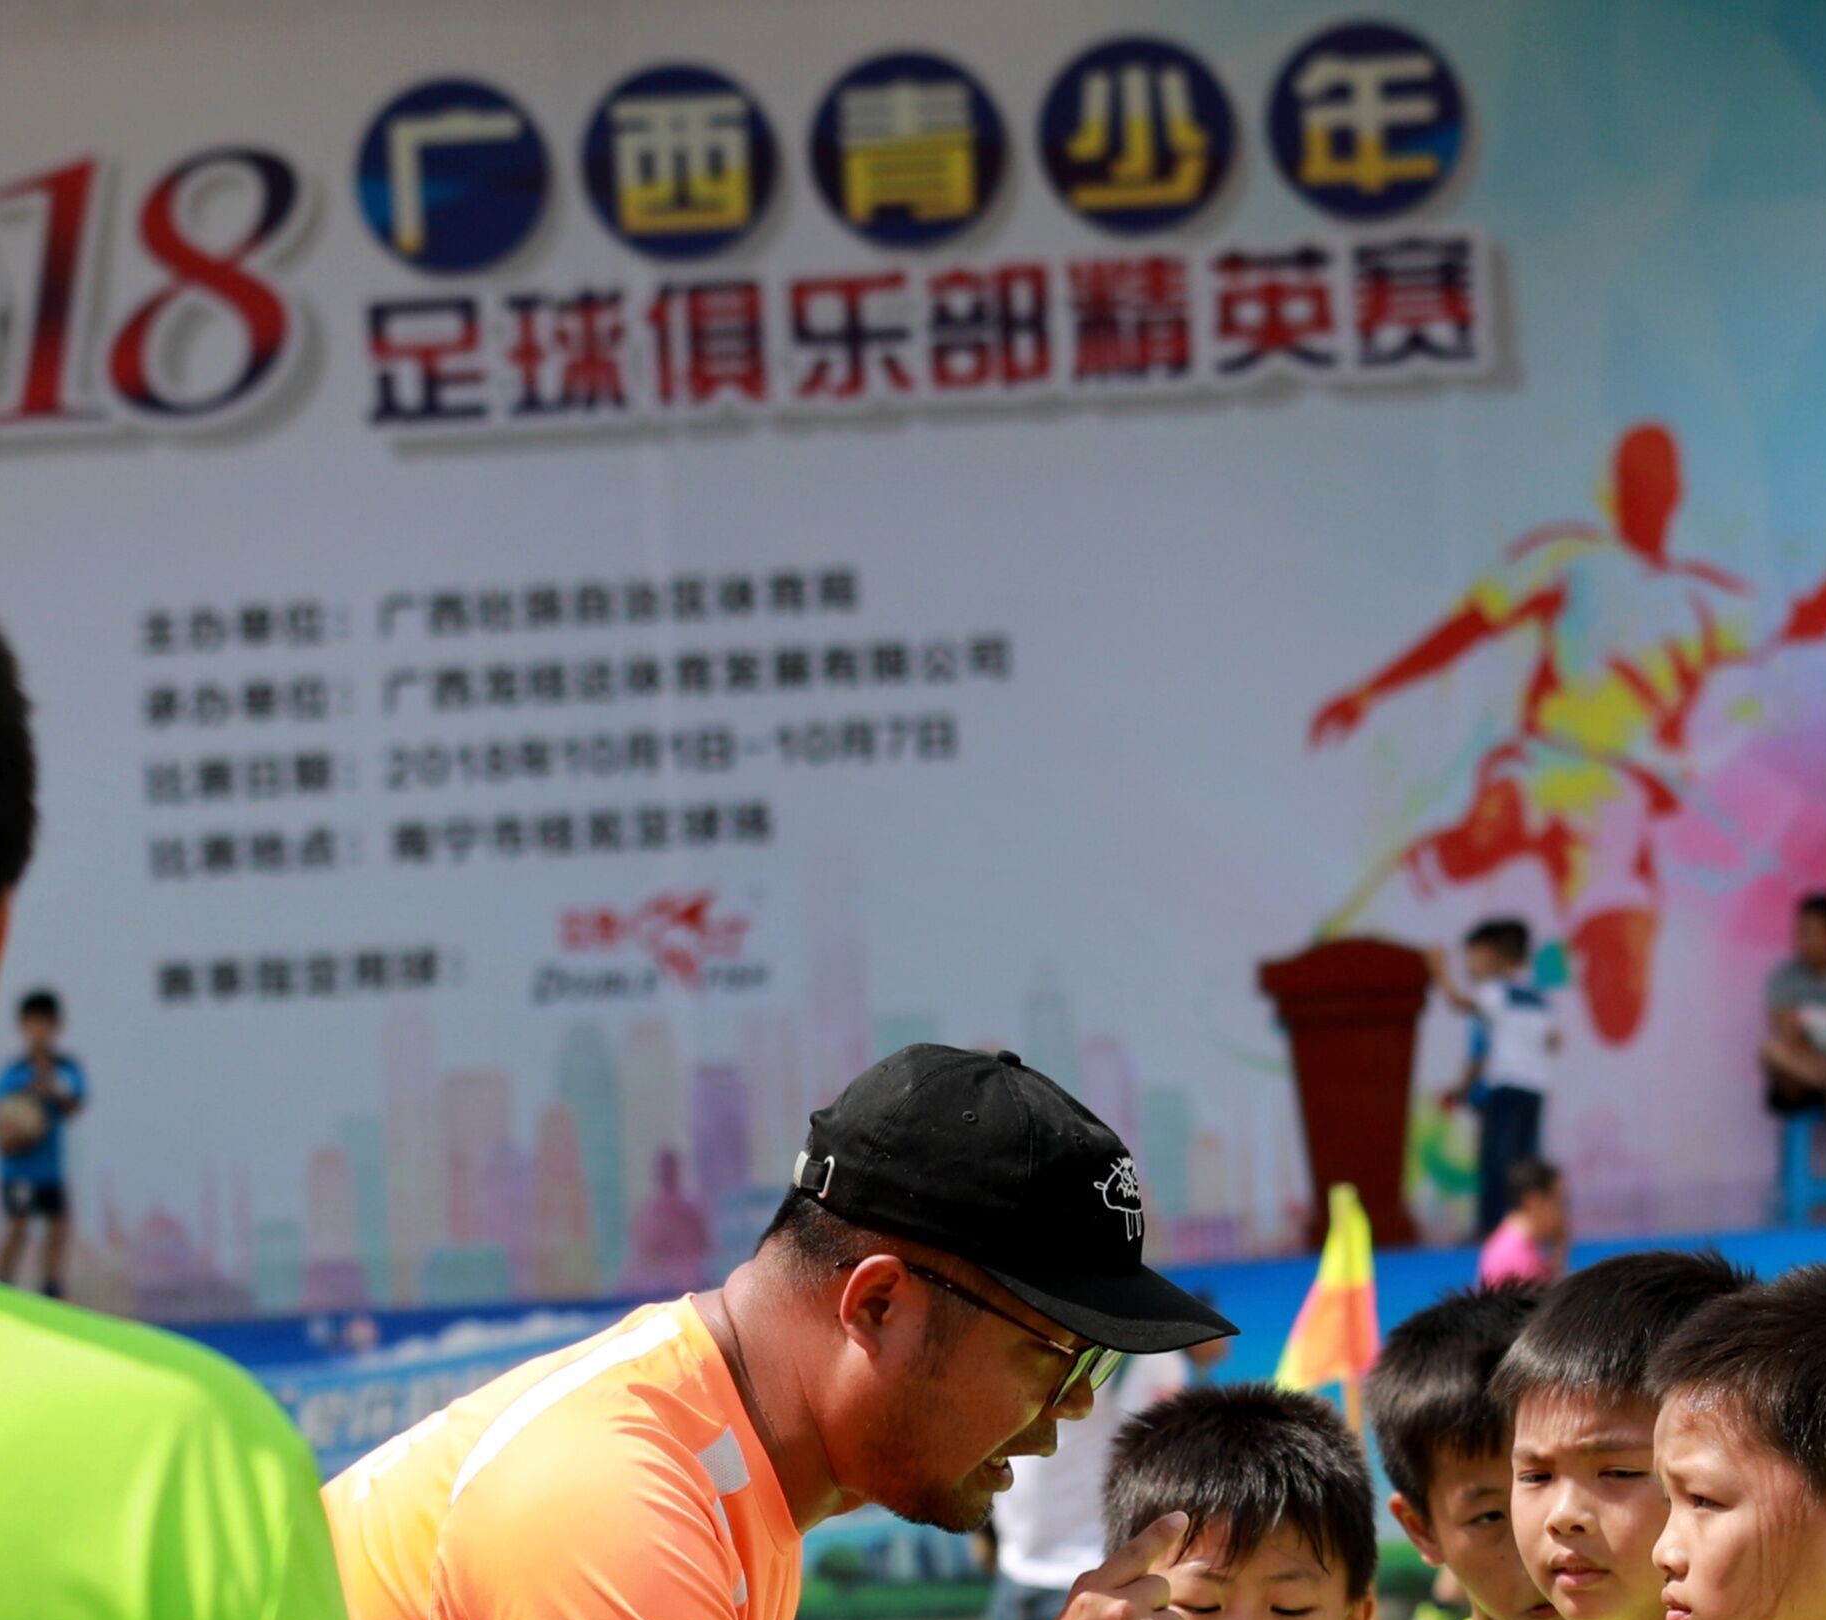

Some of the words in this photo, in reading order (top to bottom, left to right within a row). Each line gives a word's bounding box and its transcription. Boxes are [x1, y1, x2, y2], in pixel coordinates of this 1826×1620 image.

[385, 52, 1441, 255] 广西青少年
[365, 236, 1479, 426] 足球俱乐部精英赛
